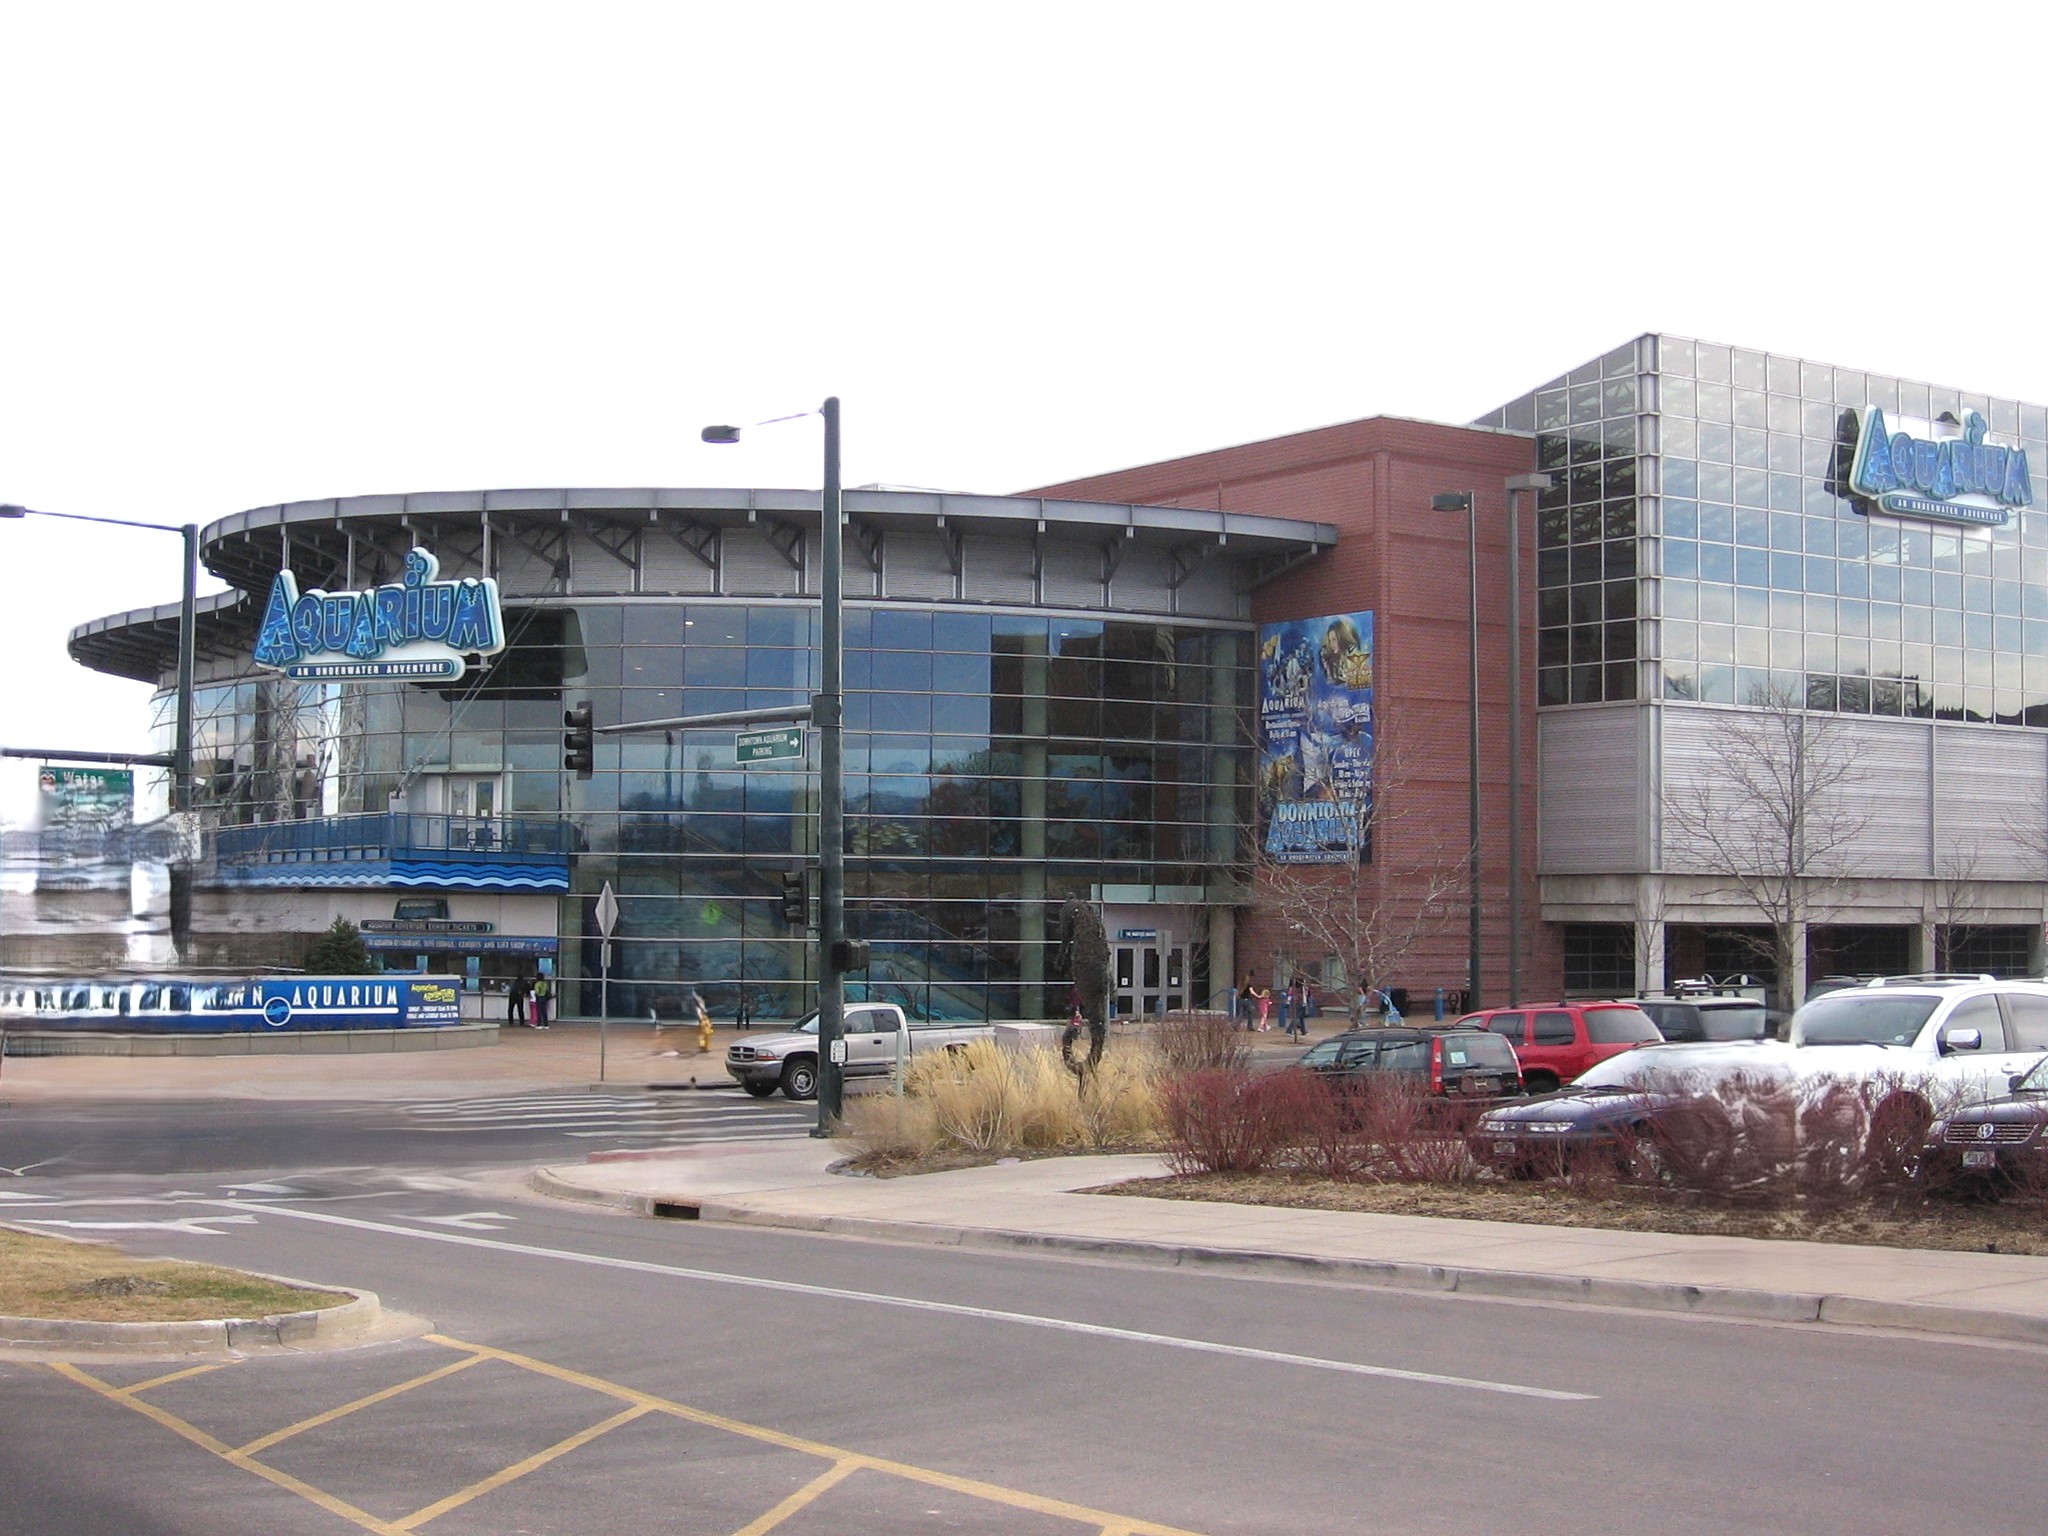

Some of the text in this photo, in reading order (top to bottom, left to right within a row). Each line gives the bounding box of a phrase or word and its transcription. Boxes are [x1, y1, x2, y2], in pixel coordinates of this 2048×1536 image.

[1861, 408, 2032, 506] AQUARIUM
[1897, 499, 2002, 522] AN UNDERWATER ADVENTURE
[253, 573, 492, 667] AQUARIUM
[296, 663, 444, 676] AN UNDERWATER ADVENTURE
[292, 985, 398, 1008] AQUARIUM
